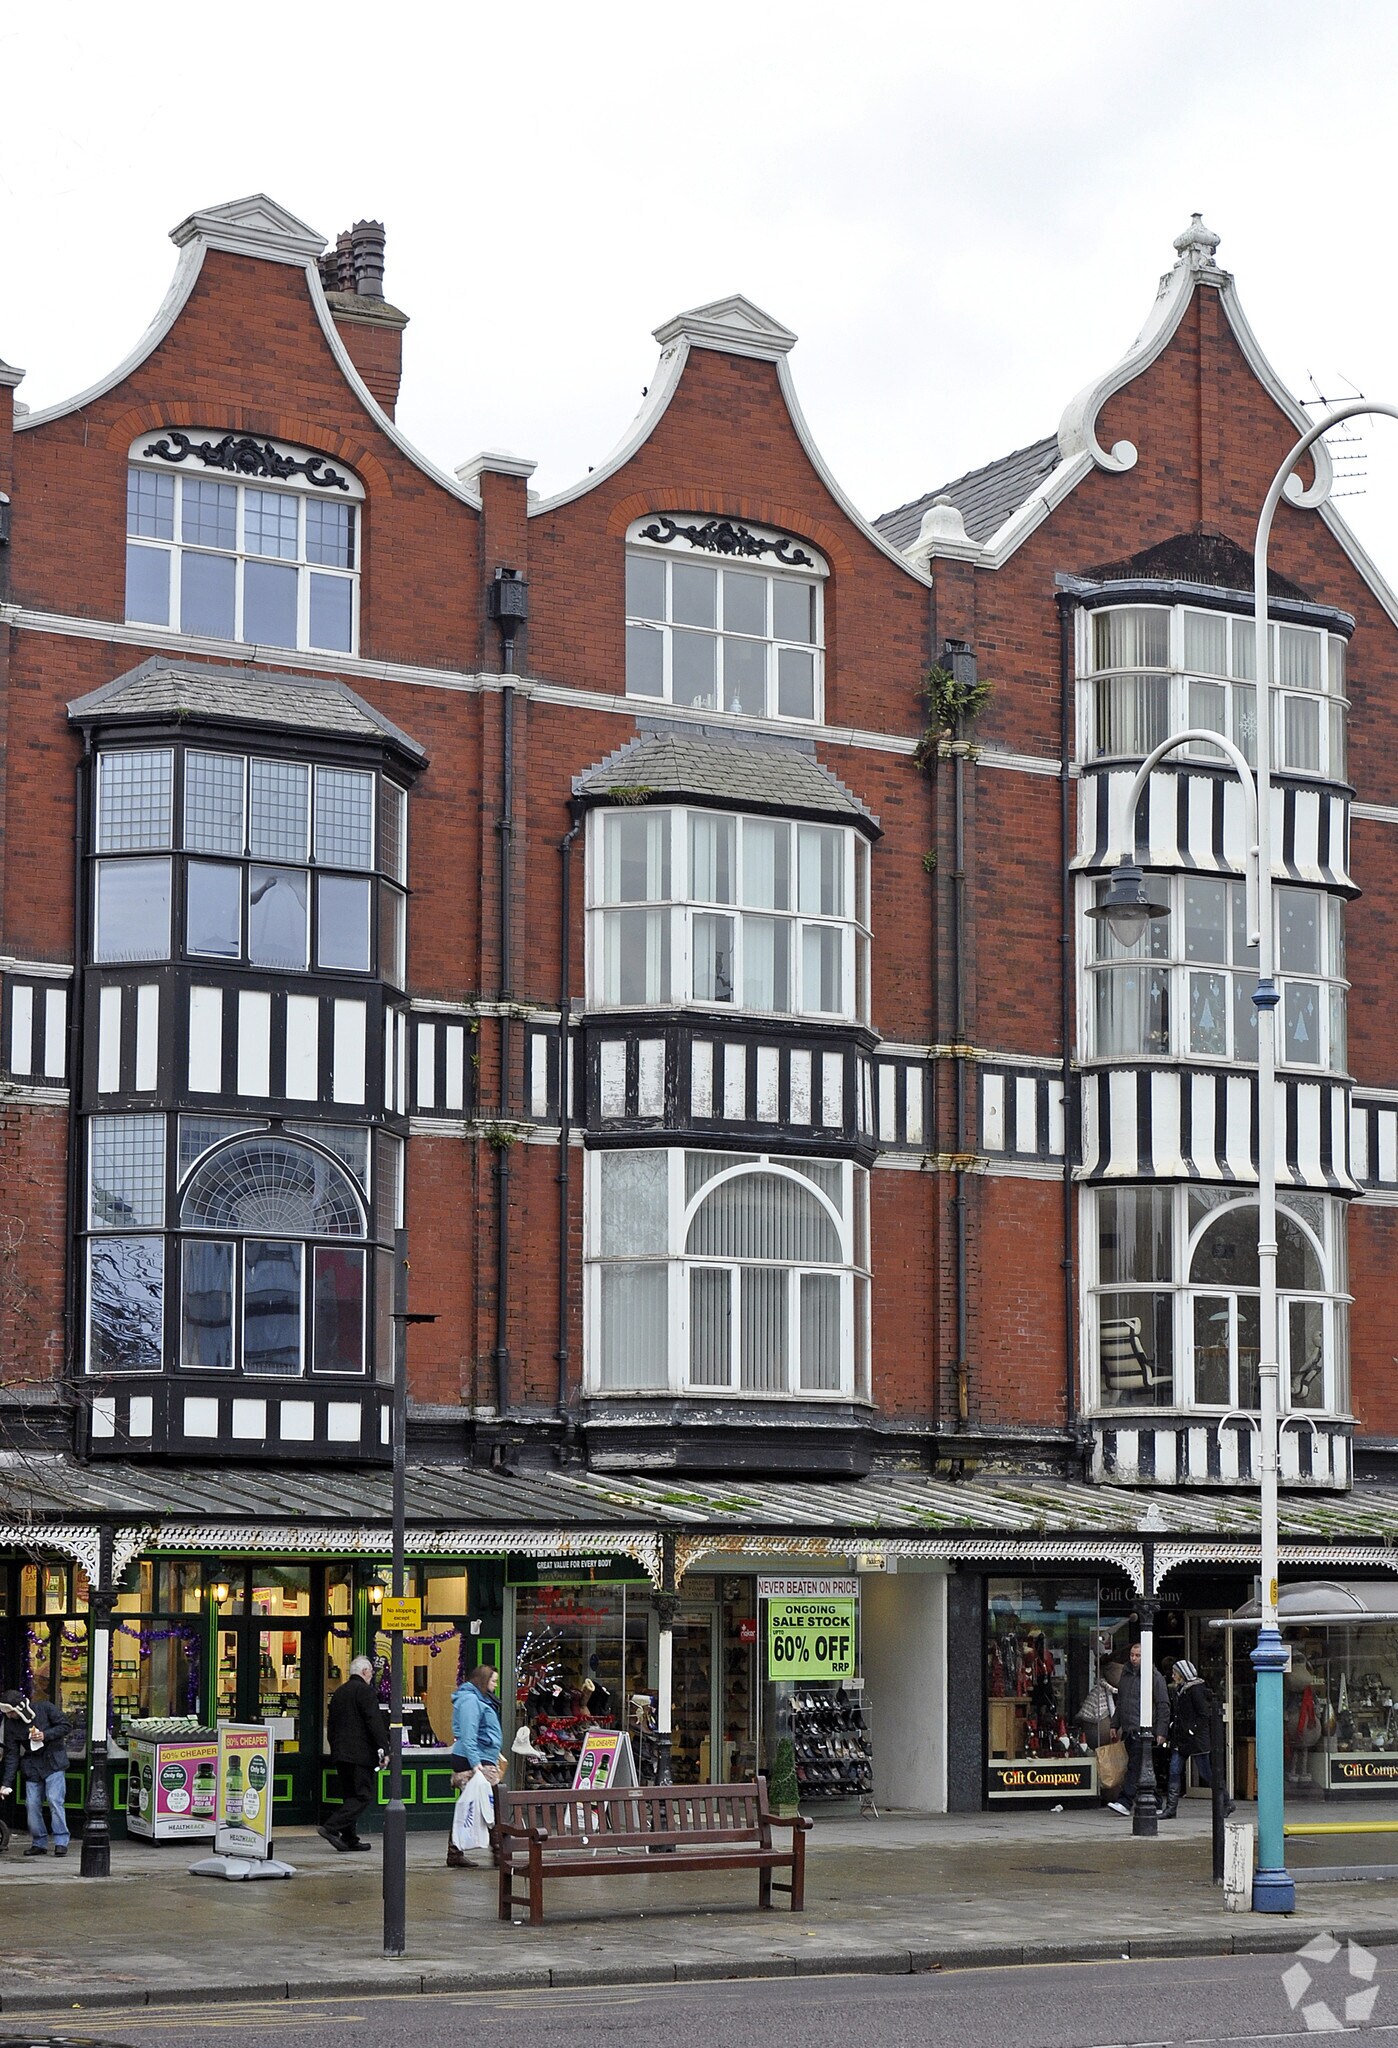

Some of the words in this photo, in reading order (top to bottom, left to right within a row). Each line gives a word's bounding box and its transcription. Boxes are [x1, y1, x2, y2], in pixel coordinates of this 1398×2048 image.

[536, 1561, 553, 1570] GREAT
[553, 1560, 569, 1569] VALUE
[570, 1560, 581, 1568] FOR
[581, 1560, 598, 1568] EVERY
[598, 1559, 612, 1567] BODY
[758, 1581, 785, 1594] NEVER
[786, 1581, 818, 1594] BEATEN
[819, 1581, 831, 1594] ON
[833, 1580, 857, 1594] PRICE
[1100, 1587, 1121, 1601] Gift
[785, 1605, 836, 1614] ONGOING
[772, 1616, 804, 1627] SALE
[807, 1616, 850, 1627] STOCK
[774, 1635, 810, 1662] 60%
[815, 1635, 850, 1661] OFF
[832, 1662, 850, 1672] RRP
[240, 1736, 268, 1746] CHEAPER
[161, 1752, 179, 1760] 50%
[180, 1747, 217, 1759] CHEAPER
[1343, 1763, 1364, 1777] Gift
[1003, 1770, 1026, 1785] Gift
[1026, 1770, 1081, 1786] Company
